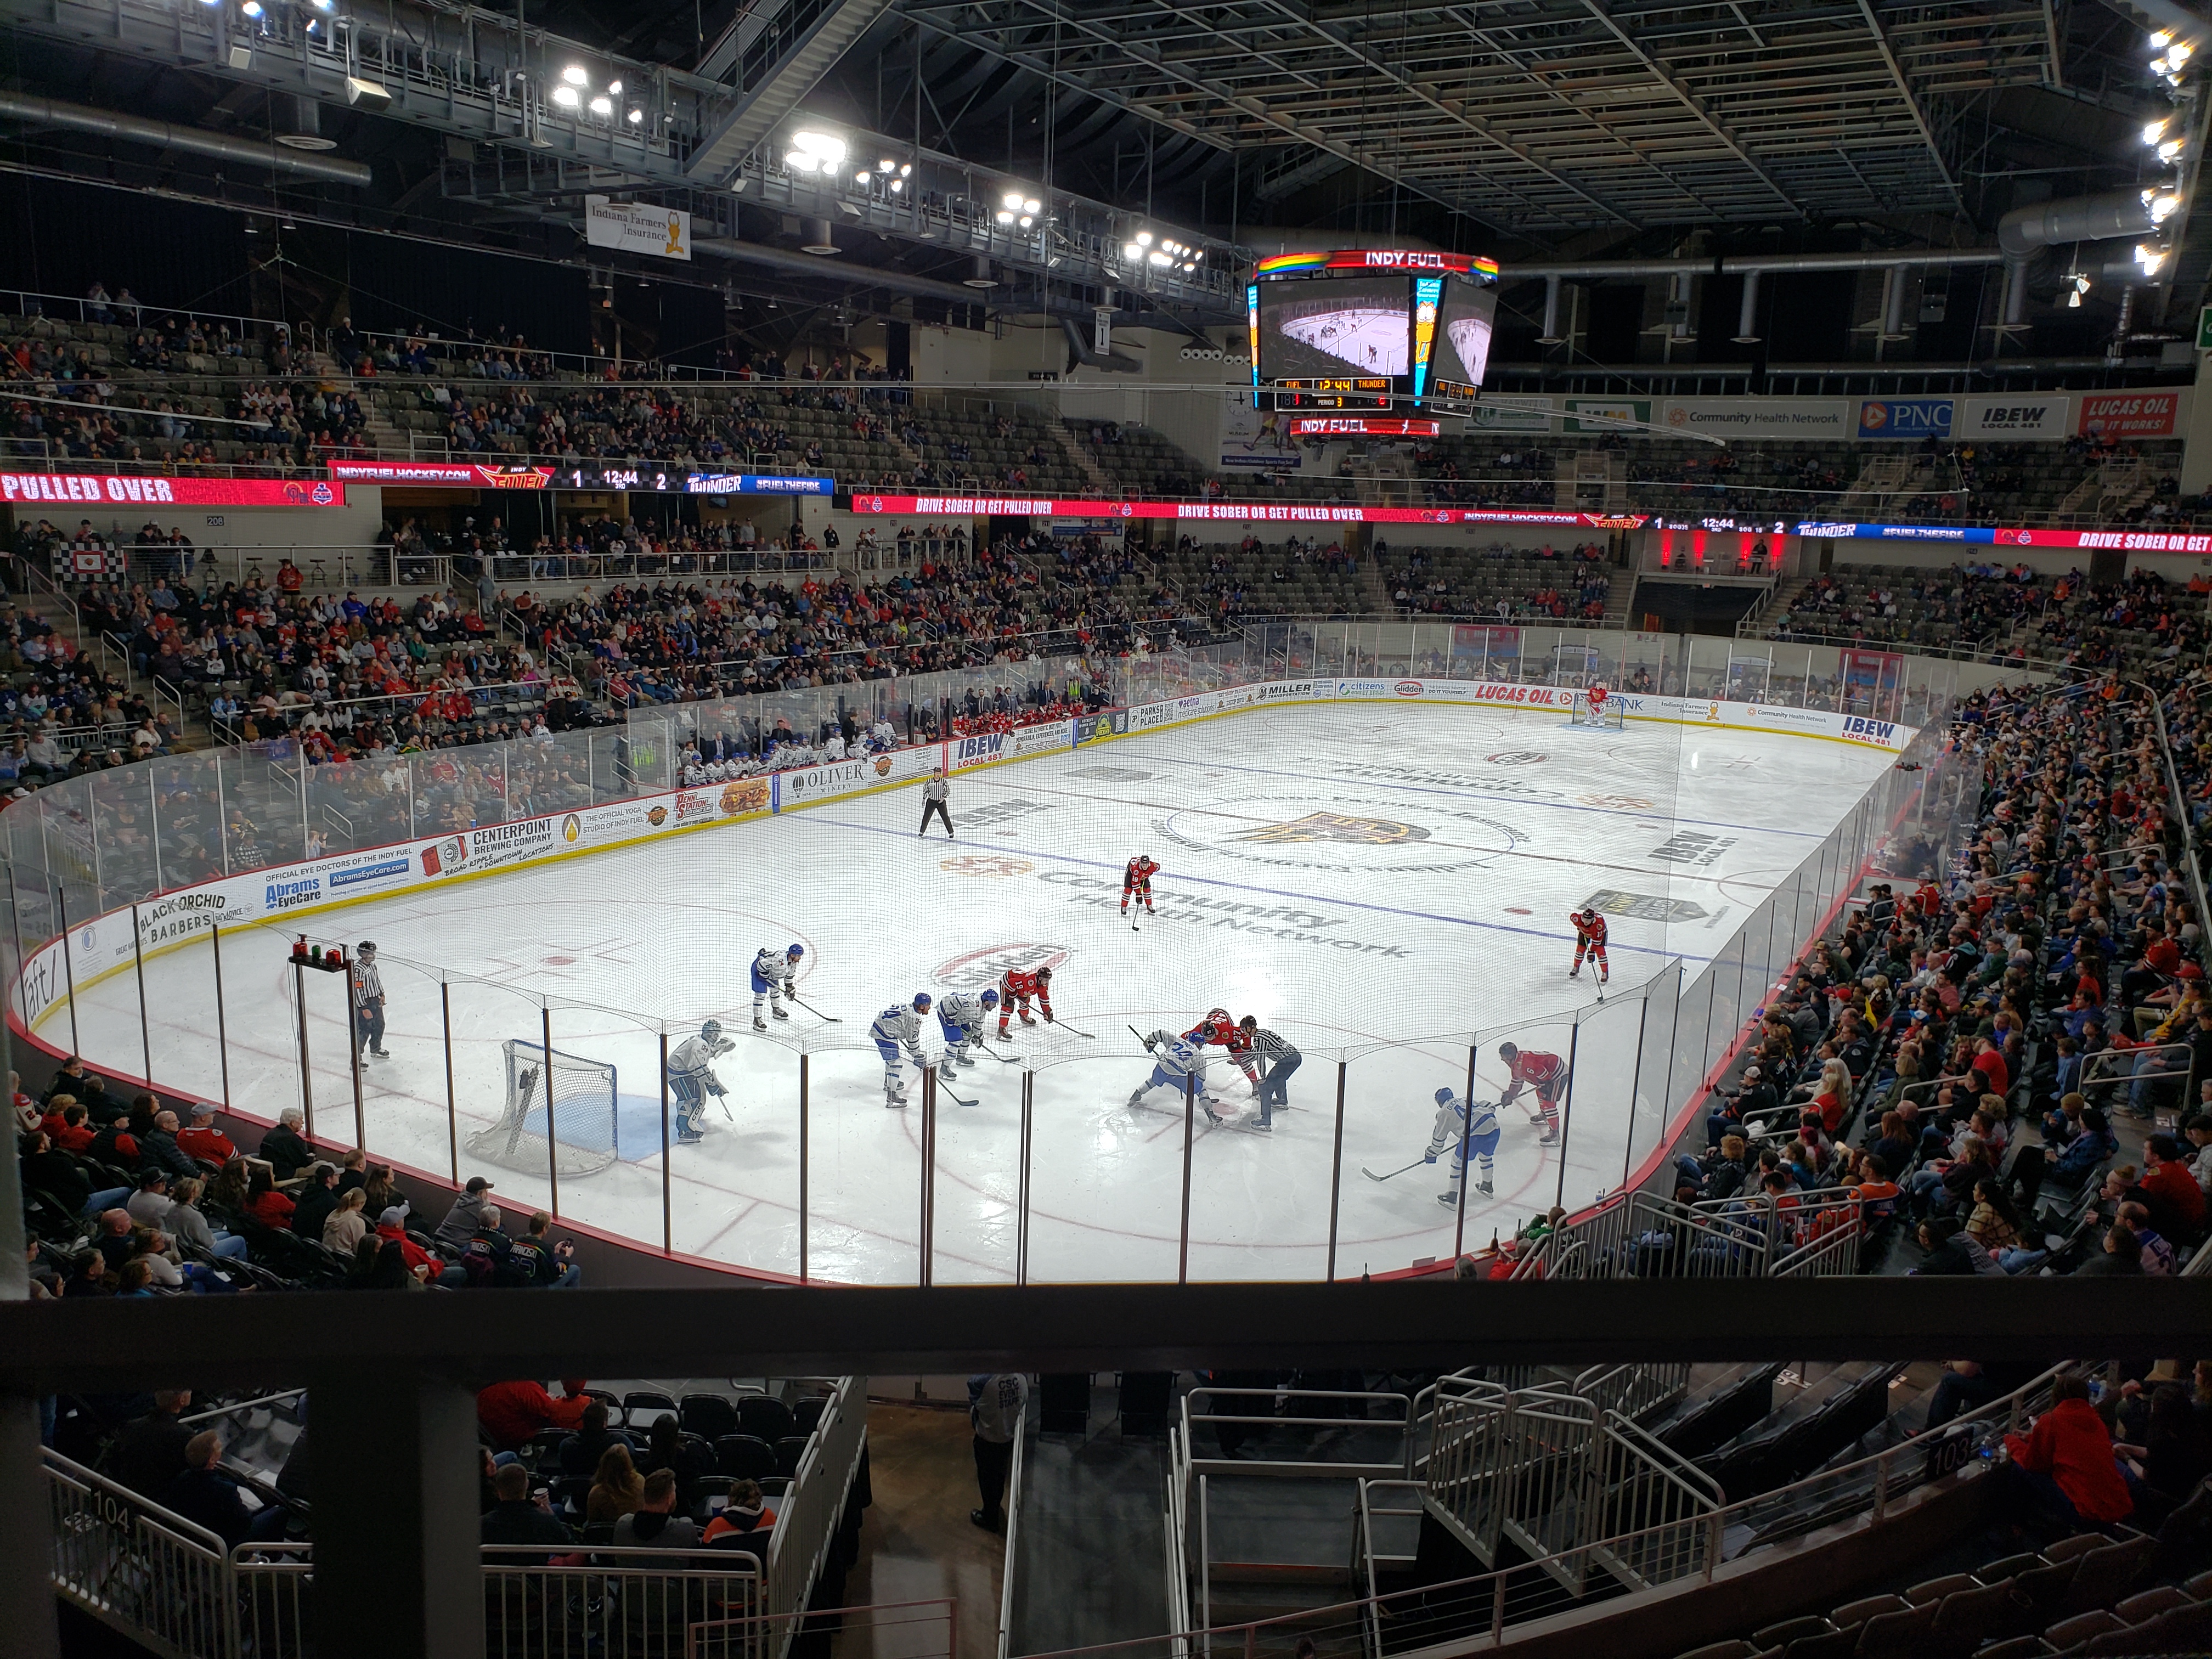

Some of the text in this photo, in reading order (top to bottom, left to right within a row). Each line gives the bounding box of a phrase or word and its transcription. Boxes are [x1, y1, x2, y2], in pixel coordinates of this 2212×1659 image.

[592, 206, 666, 229] Indiana Farmers
[624, 224, 666, 241] Insurance
[1366, 252, 1444, 267] INDY FUEL
[1358, 380, 1385, 388] THUNDER
[1337, 397, 1341, 407] 3
[2089, 398, 2169, 416] LUCAS OIL
[1689, 411, 1838, 425] Community Health Network
[1893, 405, 1952, 426] PNC
[1982, 408, 2047, 421] IBEW
[1301, 420, 1367, 432] INDY FUEL
[2108, 419, 2165, 430] IT WORKS!
[1, 475, 173, 501] PULLED OVER
[337, 467, 471, 482] INDYFUELHOCKEY.COM
[573, 471, 582, 487] 1
[603, 470, 638, 484] 12:44
[657, 473, 665, 490] 2
[687, 475, 742, 493] THUNDER
[757, 479, 821, 492] #FUELTHEFIRE
[916, 498, 1052, 515] DRIVE SOBER OR GET PULLED OVER
[1178, 504, 1363, 521] DRIVE SOBER OR GET PULLED OVER
[208, 517, 223, 525] 208
[1464, 512, 1577, 524] INDYFUELHOCKEY.COM
[1655, 517, 1662, 529] 1
[1702, 518, 1734, 528] 12:44
[1774, 522, 1784, 533] 2
[1798, 524, 1856, 538] THUNDER
[1882, 527, 1964, 540] #FUELTHEFIRE
[2079, 533, 2210, 551] DRIVE SOBER OR GET
[1269, 684, 1311, 694] MILLER
[1351, 682, 1384, 690] citizens
[1394, 684, 1424, 692] Glidden
[1475, 685, 1554, 704] LUCAS OIL
[1178, 704, 1215, 718] medicare solutions
[1183, 697, 1199, 708] aetna
[1608, 696, 1644, 711] BANK
[1661, 701, 1708, 710] Indiana Farmers
[1758, 709, 1788, 719] Community
[1843, 716, 1895, 738] IBEW
[1842, 732, 1872, 742] LOCAL
[958, 733, 1004, 759] IBEW
[958, 753, 1002, 769] LOCAL 481
[808, 764, 864, 787] OLIVER
[821, 783, 851, 793] WINERY
[676, 794, 696, 810] PENN
[677, 799, 707, 819] STATION
[599, 811, 624, 820] OFFICIAL
[474, 819, 552, 845] CENTERPOINT
[583, 825, 605, 833] STUDIO
[475, 841, 511, 855] BREWING
[515, 832, 552, 847] COMPANY
[520, 843, 554, 861] LOCATIONS
[1647, 830, 1720, 864] IBEW
[445, 854, 493, 876] BROAD RIPPLE
[485, 849, 522, 868] DOWNTOWN
[1694, 849, 1727, 866] LOCAL
[266, 871, 299, 882] OFFICIAL
[316, 861, 351, 871] DOCTORS
[363, 855, 377, 863] THE
[379, 851, 394, 861] INDY
[332, 863, 407, 884] AbramsEyeCare.com
[266, 878, 320, 903] Abrams
[278, 890, 321, 907] EyeCare
[140, 894, 225, 933] BLACK ORCHID
[151, 915, 211, 943] BARBERS
[1210, 917, 1414, 959] Network
[116, 944, 127, 956] GREAT
[1015, 980, 1024, 990] 19
[998, 1377, 1019, 1389] CSC
[998, 1387, 1019, 1400] EVENT
[998, 1396, 1019, 1409] STAFF
[1934, 1437, 1970, 1475] 103
[94, 1489, 130, 1533] 104
